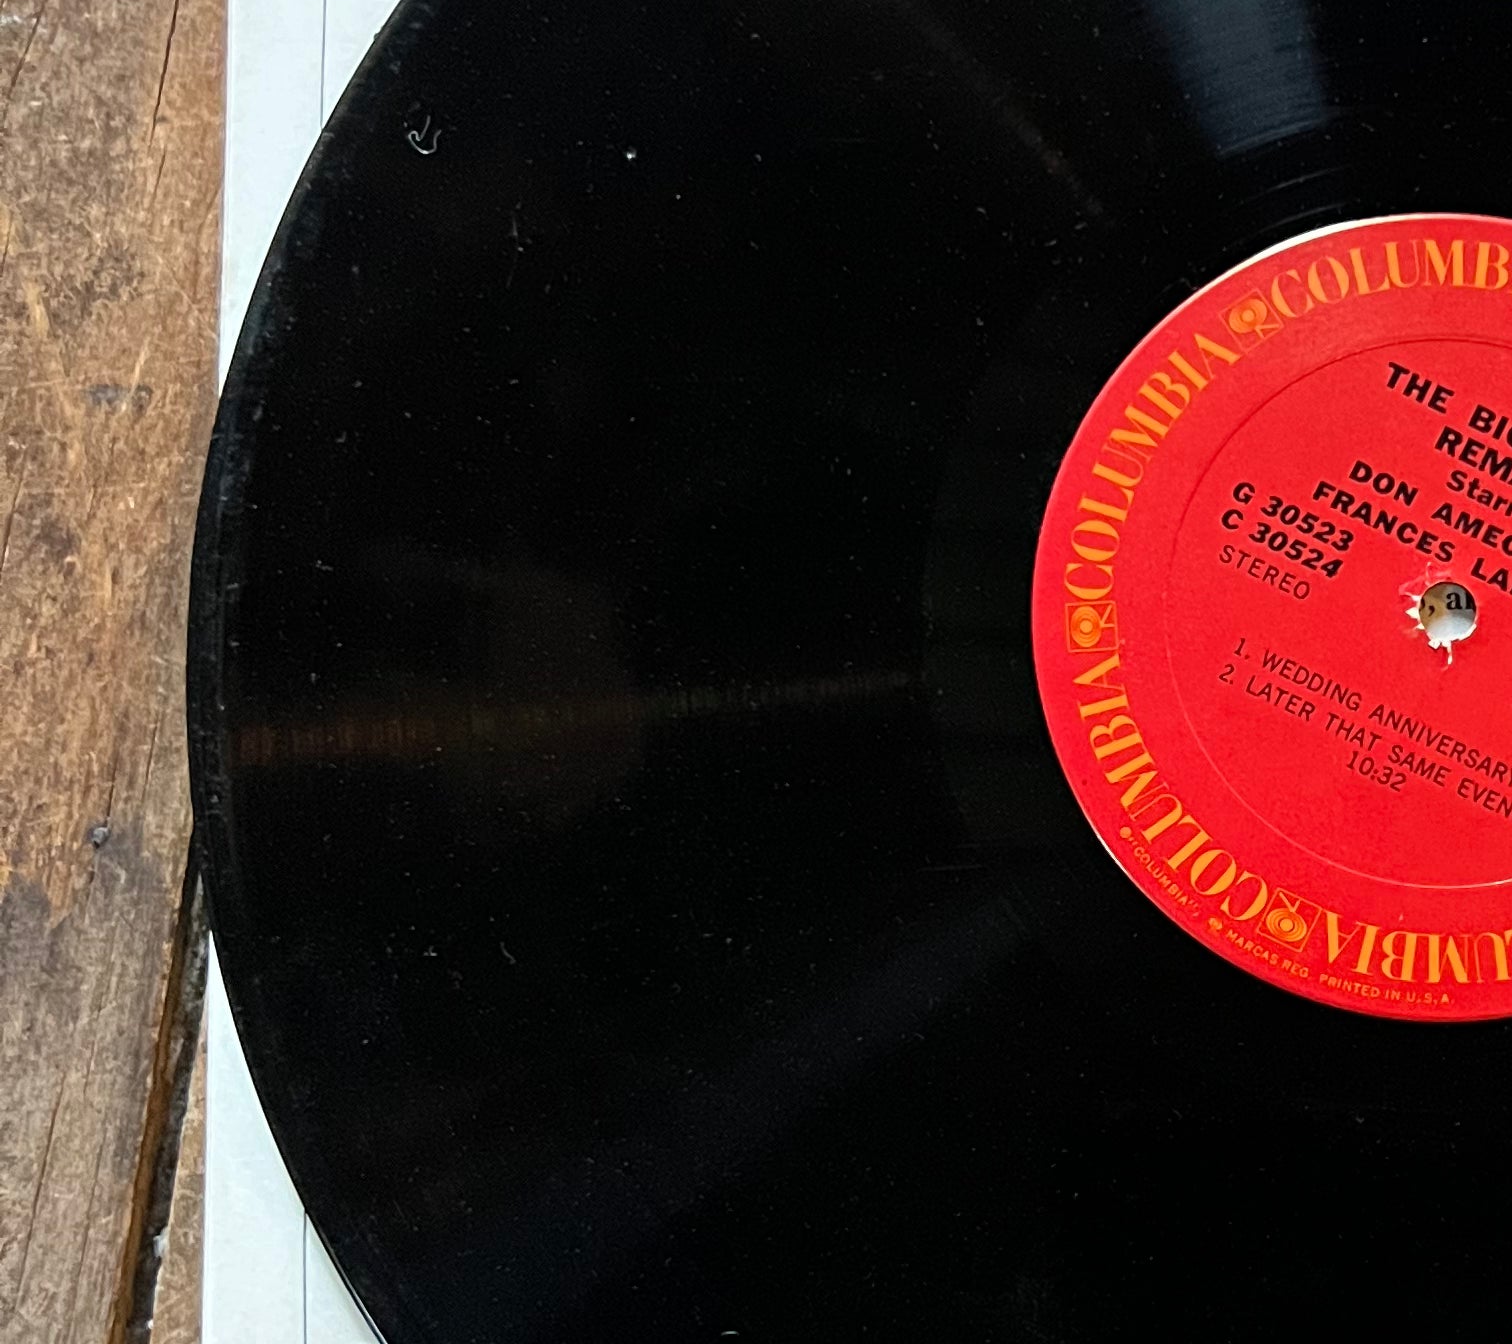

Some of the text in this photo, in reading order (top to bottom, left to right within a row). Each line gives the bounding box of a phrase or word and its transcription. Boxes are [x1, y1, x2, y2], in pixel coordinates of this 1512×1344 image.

[1386, 361, 1455, 414] THE
[1063, 331, 1241, 600] COLUMBIA
[1349, 459, 1419, 506] DON
[1221, 508, 1345, 579] C 30524
[1232, 481, 1356, 553] G 30523
[1312, 481, 1456, 563] FRANCES
[1219, 543, 1311, 601] STEREO
[1233, 637, 1250, 661] 1.
[1262, 648, 1362, 712] WEDDING
[1218, 663, 1235, 686] 2.
[1245, 674, 1316, 722] LATER
[1324, 712, 1382, 753] THAT
[1386, 744, 1452, 787] SAME
[1071, 653, 1268, 921] COLUMBIA
[1345, 750, 1408, 793] 10:32
